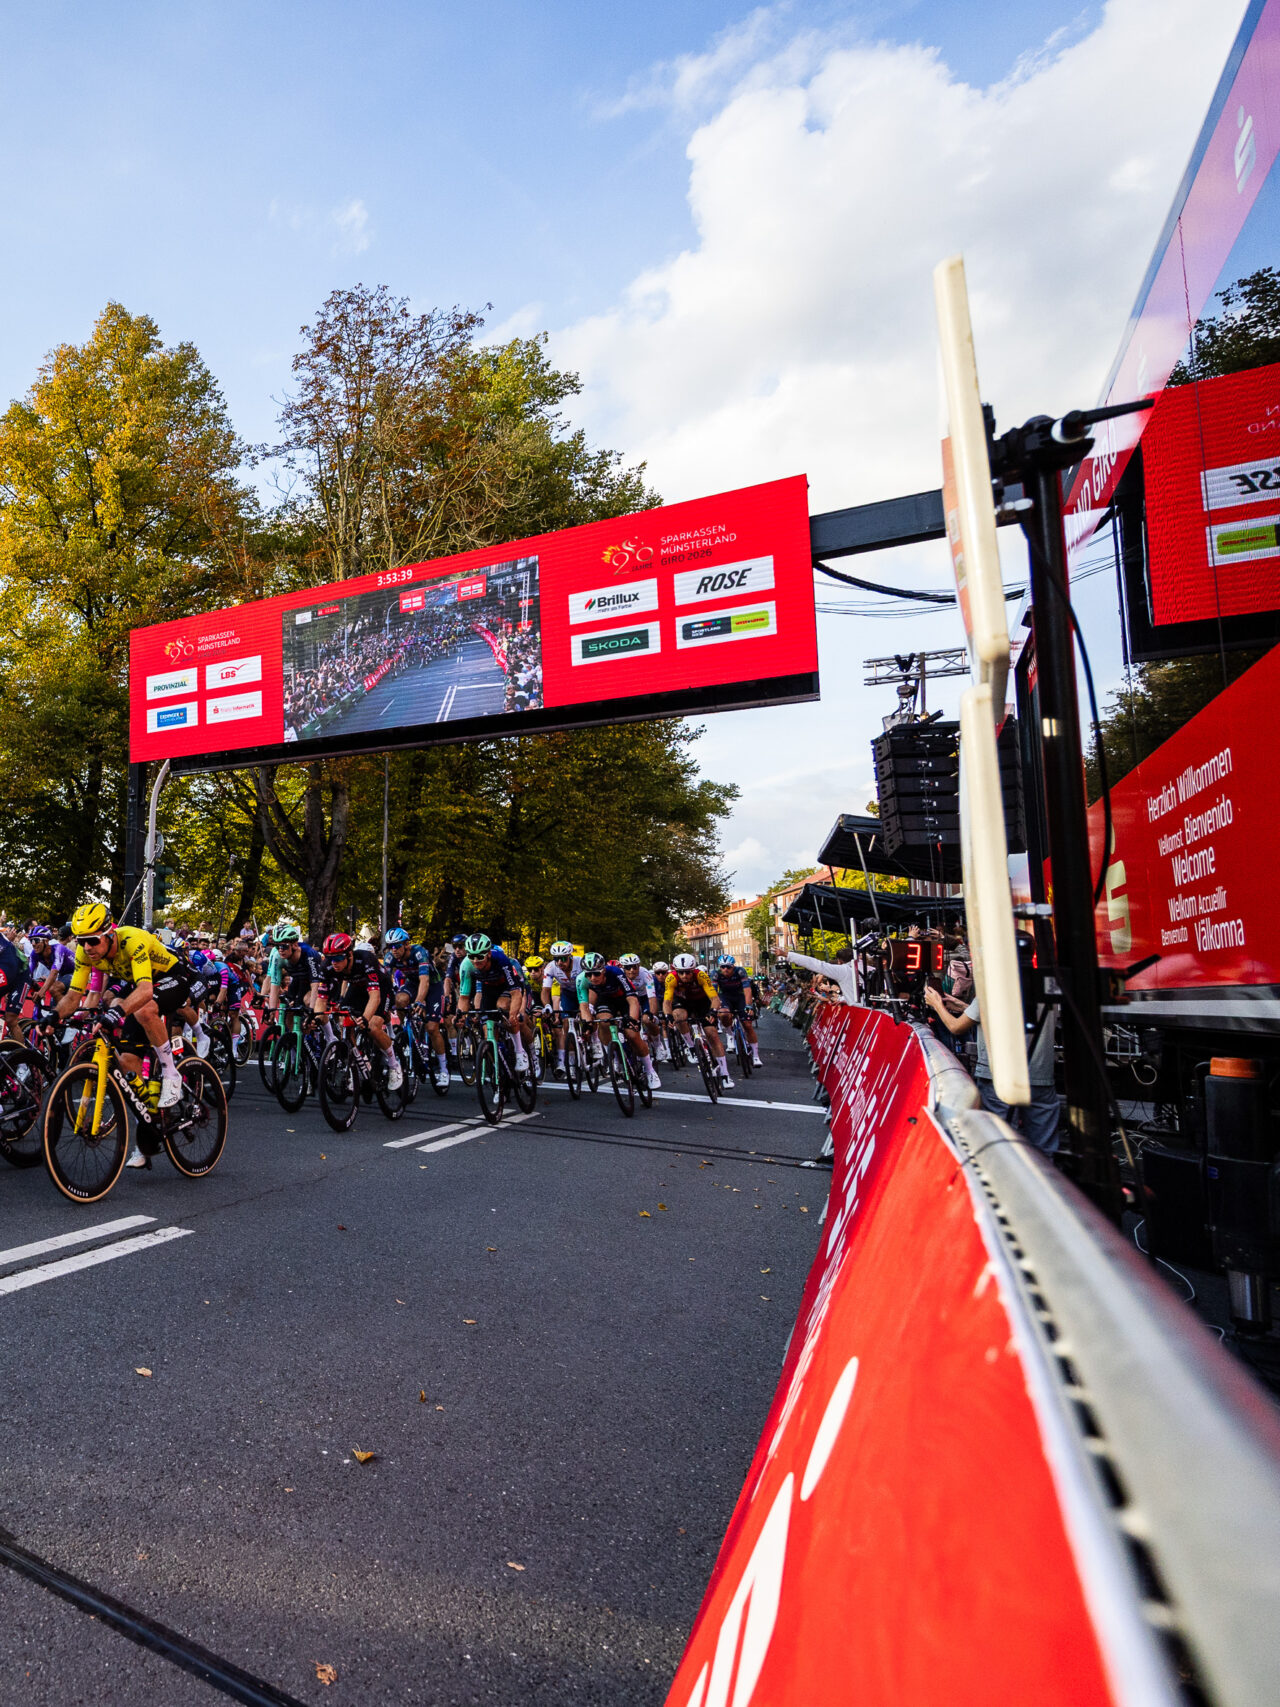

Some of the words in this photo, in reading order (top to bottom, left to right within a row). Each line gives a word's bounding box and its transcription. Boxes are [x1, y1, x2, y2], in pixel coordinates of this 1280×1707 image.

[660, 533, 737, 556] MÜNSTERLAND
[661, 524, 726, 545] SPARKASSEN
[661, 554, 685, 566] GIRO
[687, 548, 712, 560] 2026
[377, 569, 413, 586] 3:53:39
[696, 568, 752, 594] ROSE
[598, 592, 640, 607] Brillux
[198, 630, 235, 644] SPARKASSEN
[153, 681, 187, 692] PROVINZIAL
[220, 670, 236, 680] LBS
[1147, 780, 1177, 823] Herzlich
[1176, 747, 1233, 804] Willkommen
[1184, 793, 1233, 845] Bienvenido
[1171, 846, 1216, 887] Welcome
[1168, 893, 1197, 922] Welkom
[1161, 925, 1188, 946] Benvenuto
[1194, 917, 1245, 952] Välkomna
[113, 1068, 152, 1124] cervélo
